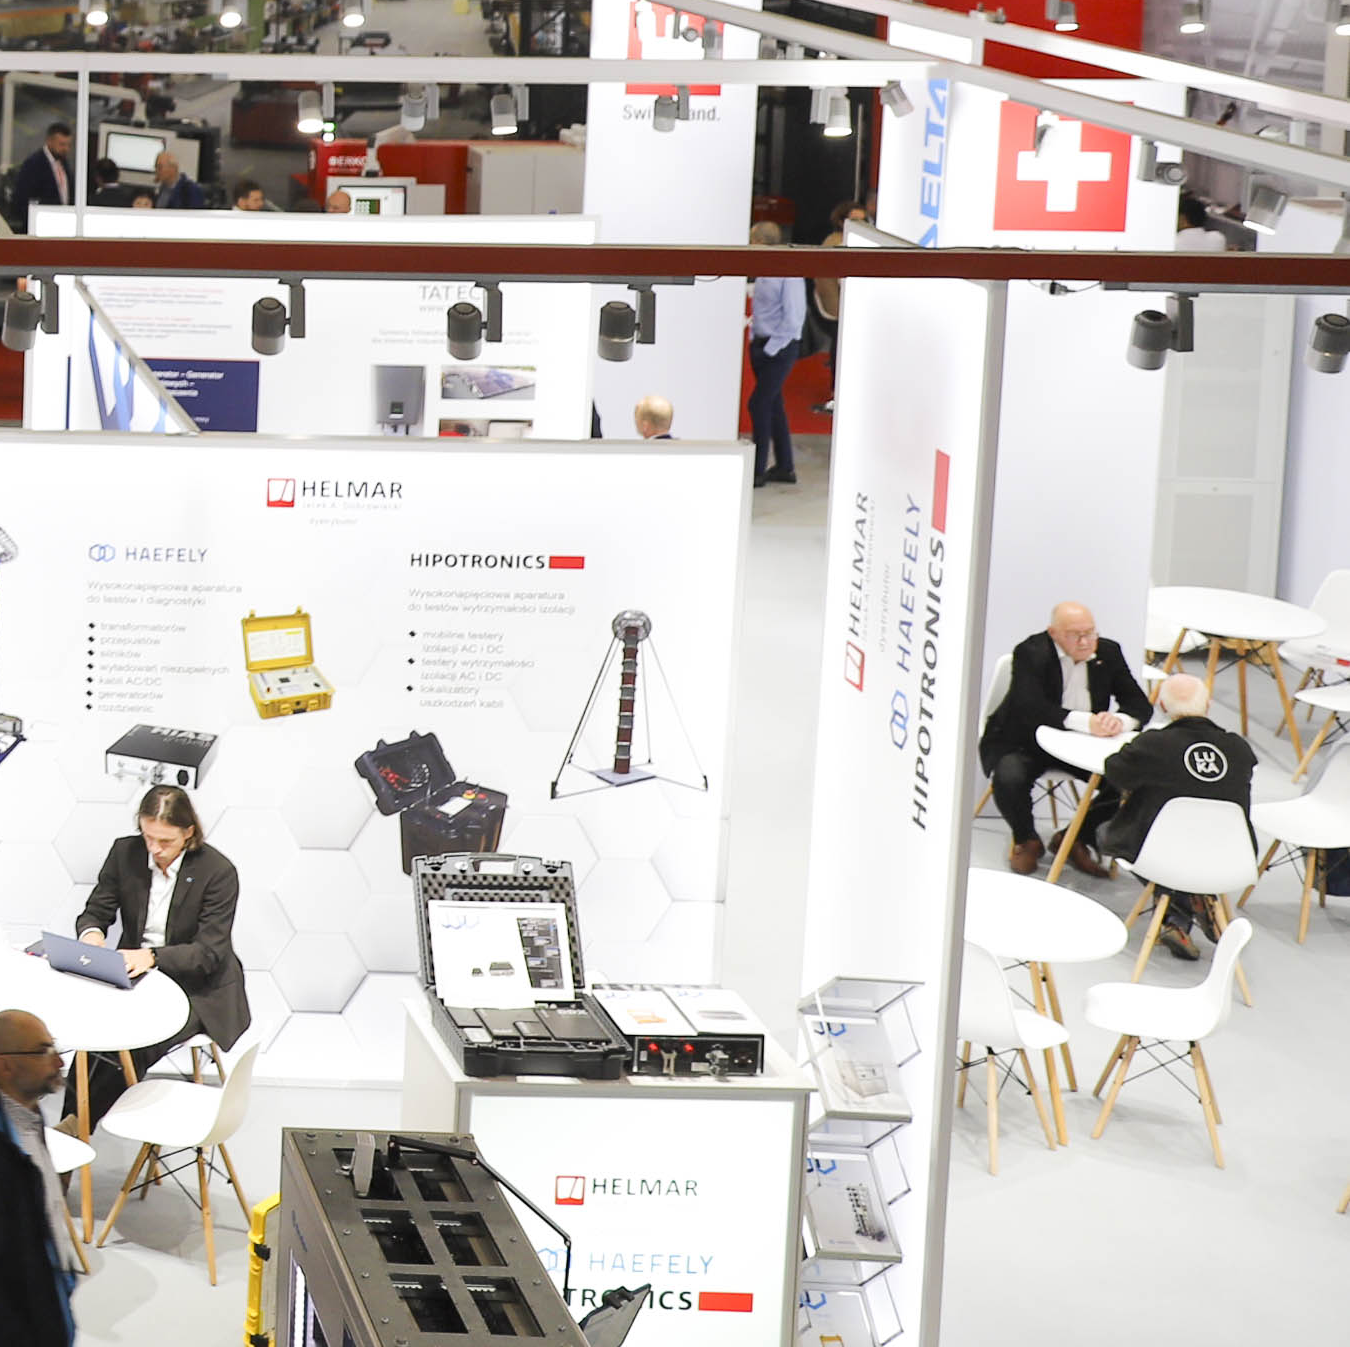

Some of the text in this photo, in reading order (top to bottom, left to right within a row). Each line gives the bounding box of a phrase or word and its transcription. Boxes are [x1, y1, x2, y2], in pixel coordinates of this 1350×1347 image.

[622, 103, 722, 122] Swiand.
[302, 479, 402, 499] HELMAR
[125, 546, 209, 563] HAEFELY
[410, 553, 546, 569] HIPOTRONICS
[848, 491, 869, 637] HELMAR
[897, 493, 922, 673] HAEFELY
[911, 535, 945, 831] HIPOTRONICS
[591, 1178, 698, 1196] HELMAR
[589, 1253, 714, 1275] HAEFELY
